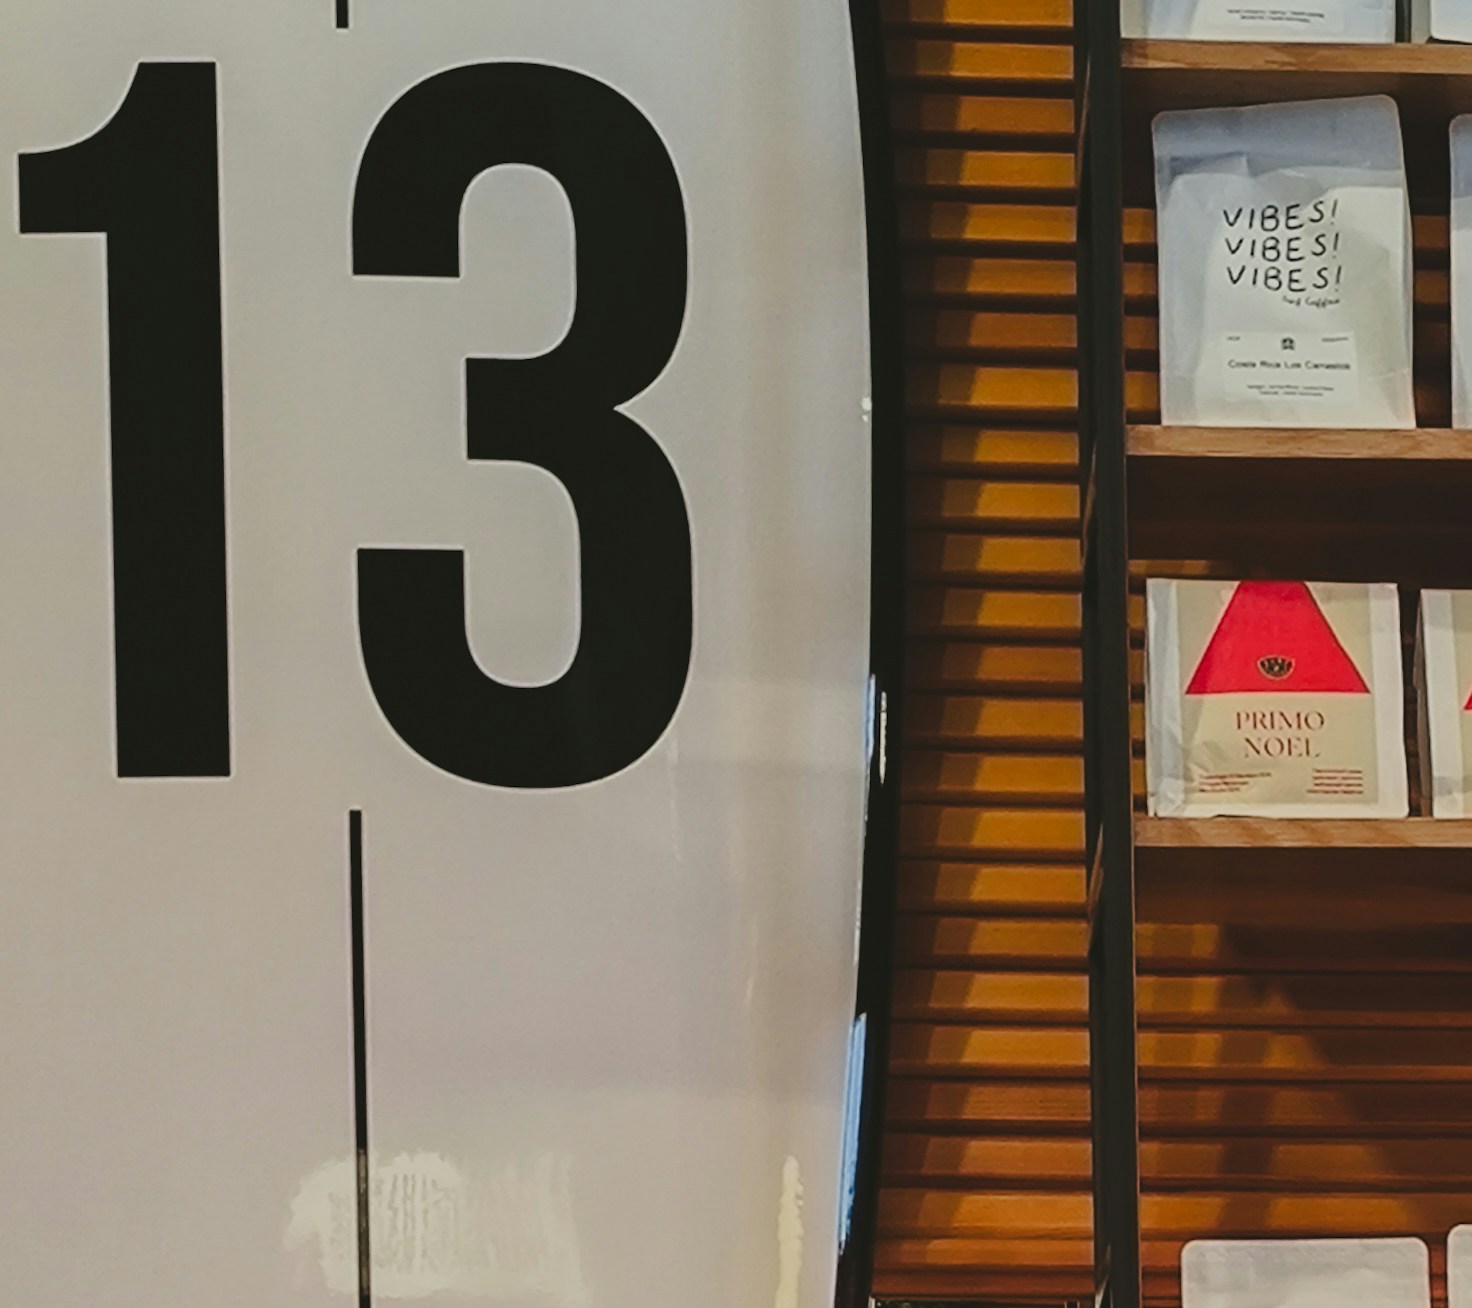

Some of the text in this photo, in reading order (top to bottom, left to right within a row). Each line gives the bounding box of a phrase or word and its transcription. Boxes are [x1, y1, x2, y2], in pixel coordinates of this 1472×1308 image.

[1223, 199, 1338, 232] VIBES!
[1225, 232, 1340, 262] VIBES!
[1227, 265, 1342, 292] VIBES!
[18, 60, 694, 789] 13
[1236, 711, 1325, 731] PRIMO
[1244, 736, 1320, 758] NOEL
